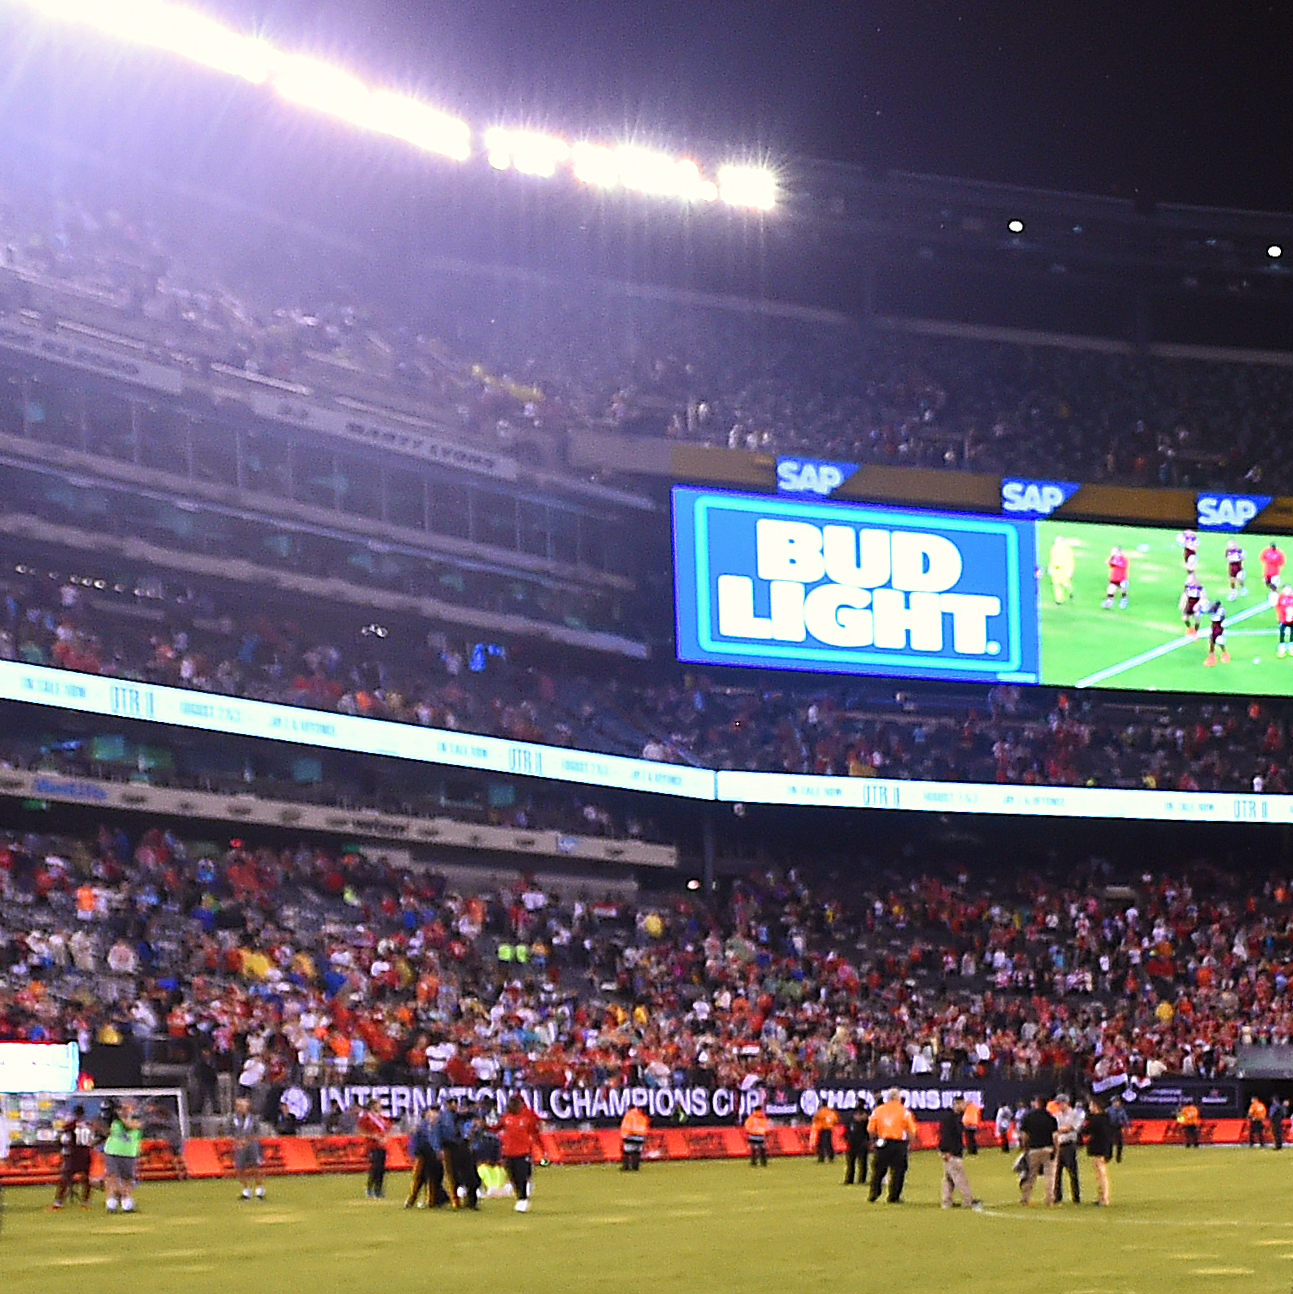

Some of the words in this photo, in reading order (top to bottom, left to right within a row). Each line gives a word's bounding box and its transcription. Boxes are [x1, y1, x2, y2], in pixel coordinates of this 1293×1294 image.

[777, 462, 842, 494] SAP
[1001, 482, 1064, 514] SAP
[1197, 496, 1257, 528] SAP
[757, 518, 962, 593] BUD
